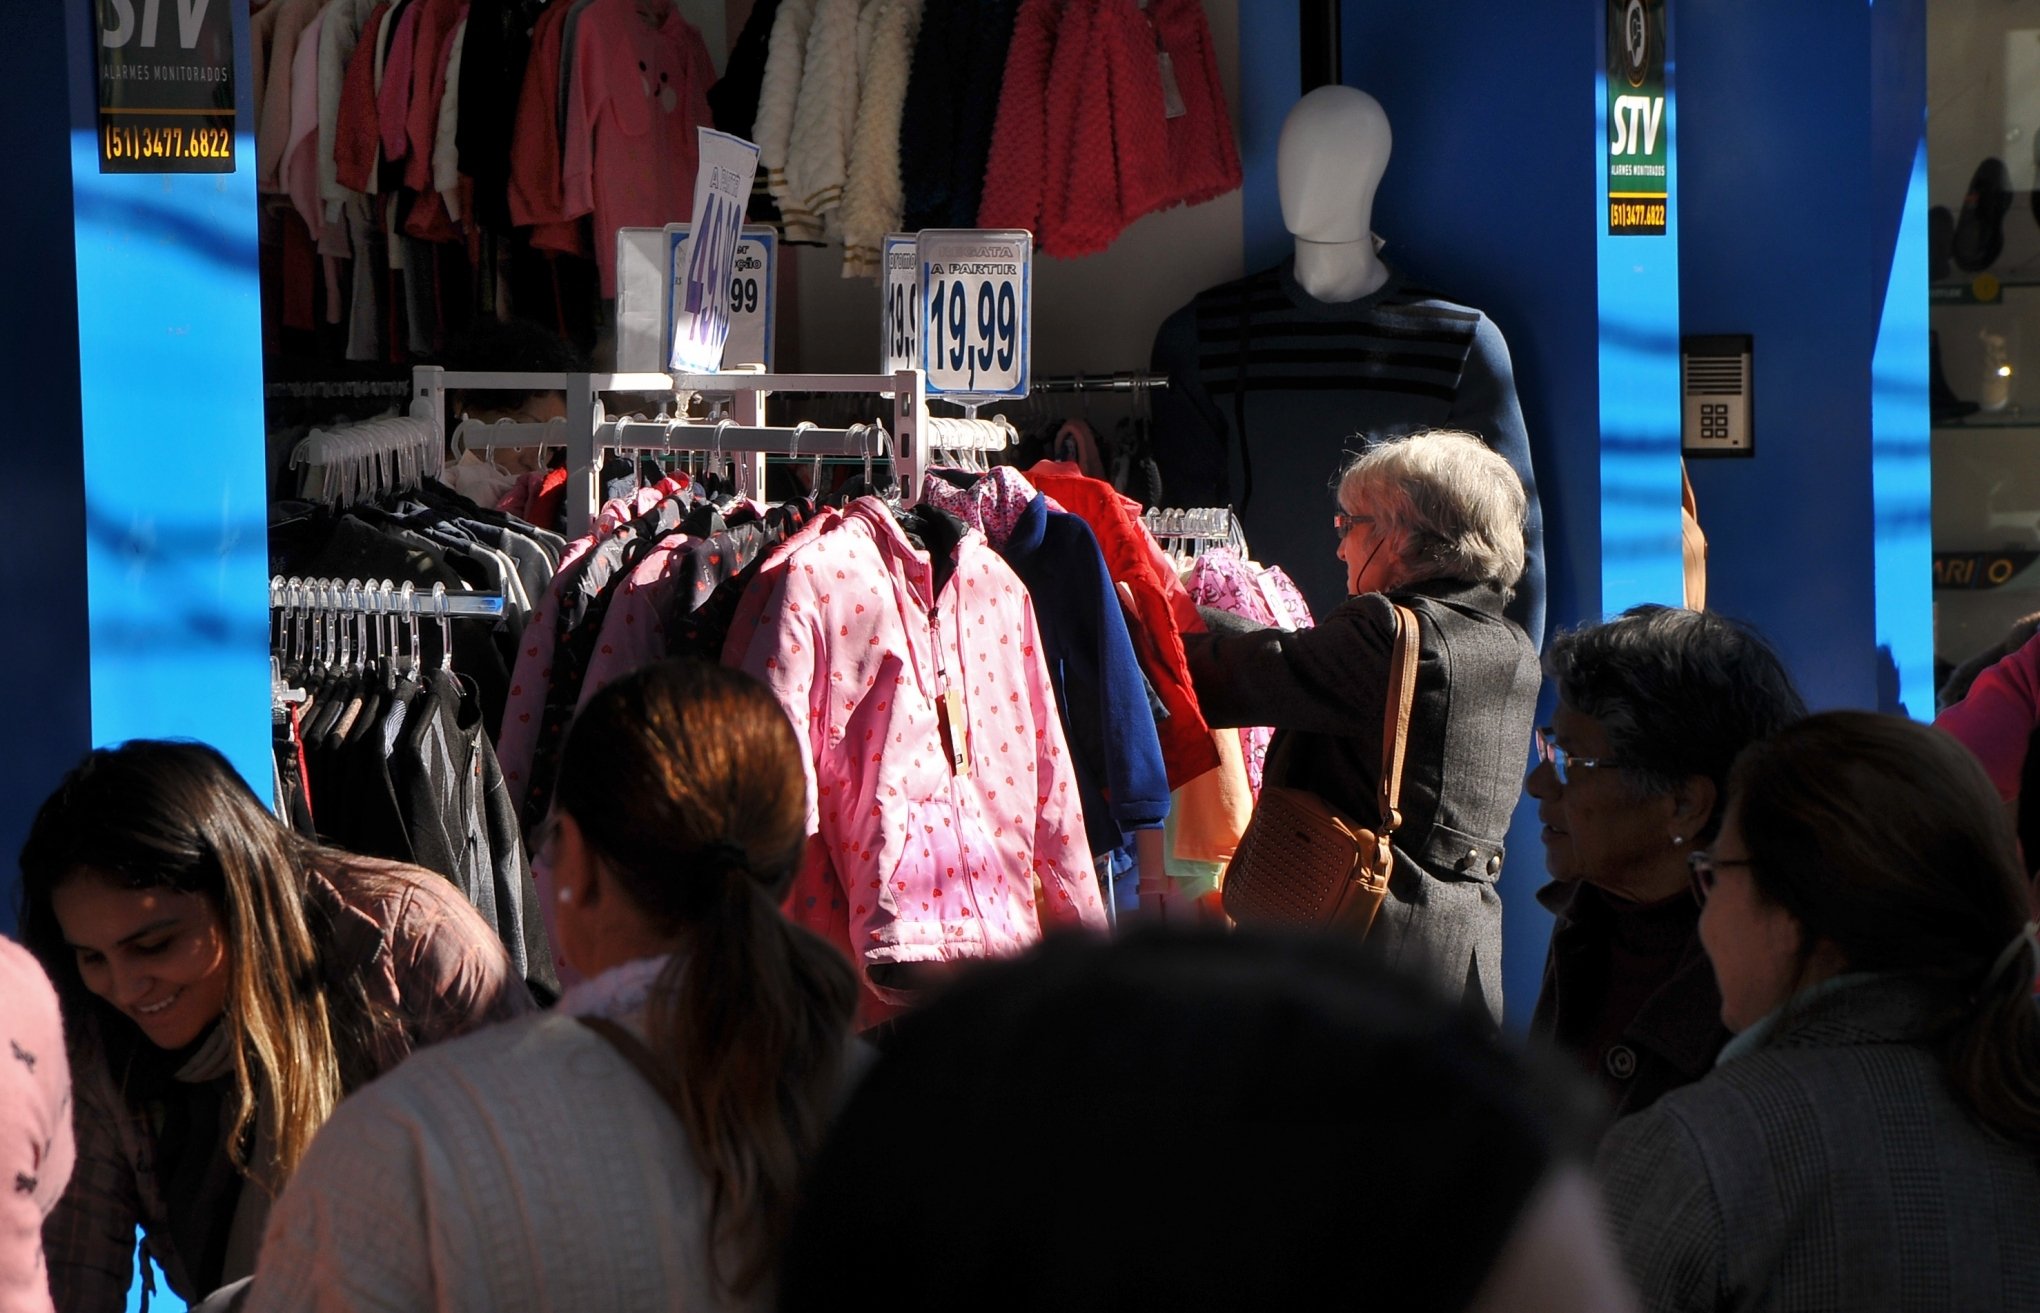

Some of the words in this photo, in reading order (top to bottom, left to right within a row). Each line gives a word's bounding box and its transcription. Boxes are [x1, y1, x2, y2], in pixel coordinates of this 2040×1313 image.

[103, 65, 150, 80] ALARMES
[153, 65, 228, 82] MONITORADOS
[1611, 95, 1664, 156] STV
[931, 264, 945, 275] A
[949, 264, 1017, 275] PARTIR
[931, 280, 1016, 391] 19,99
